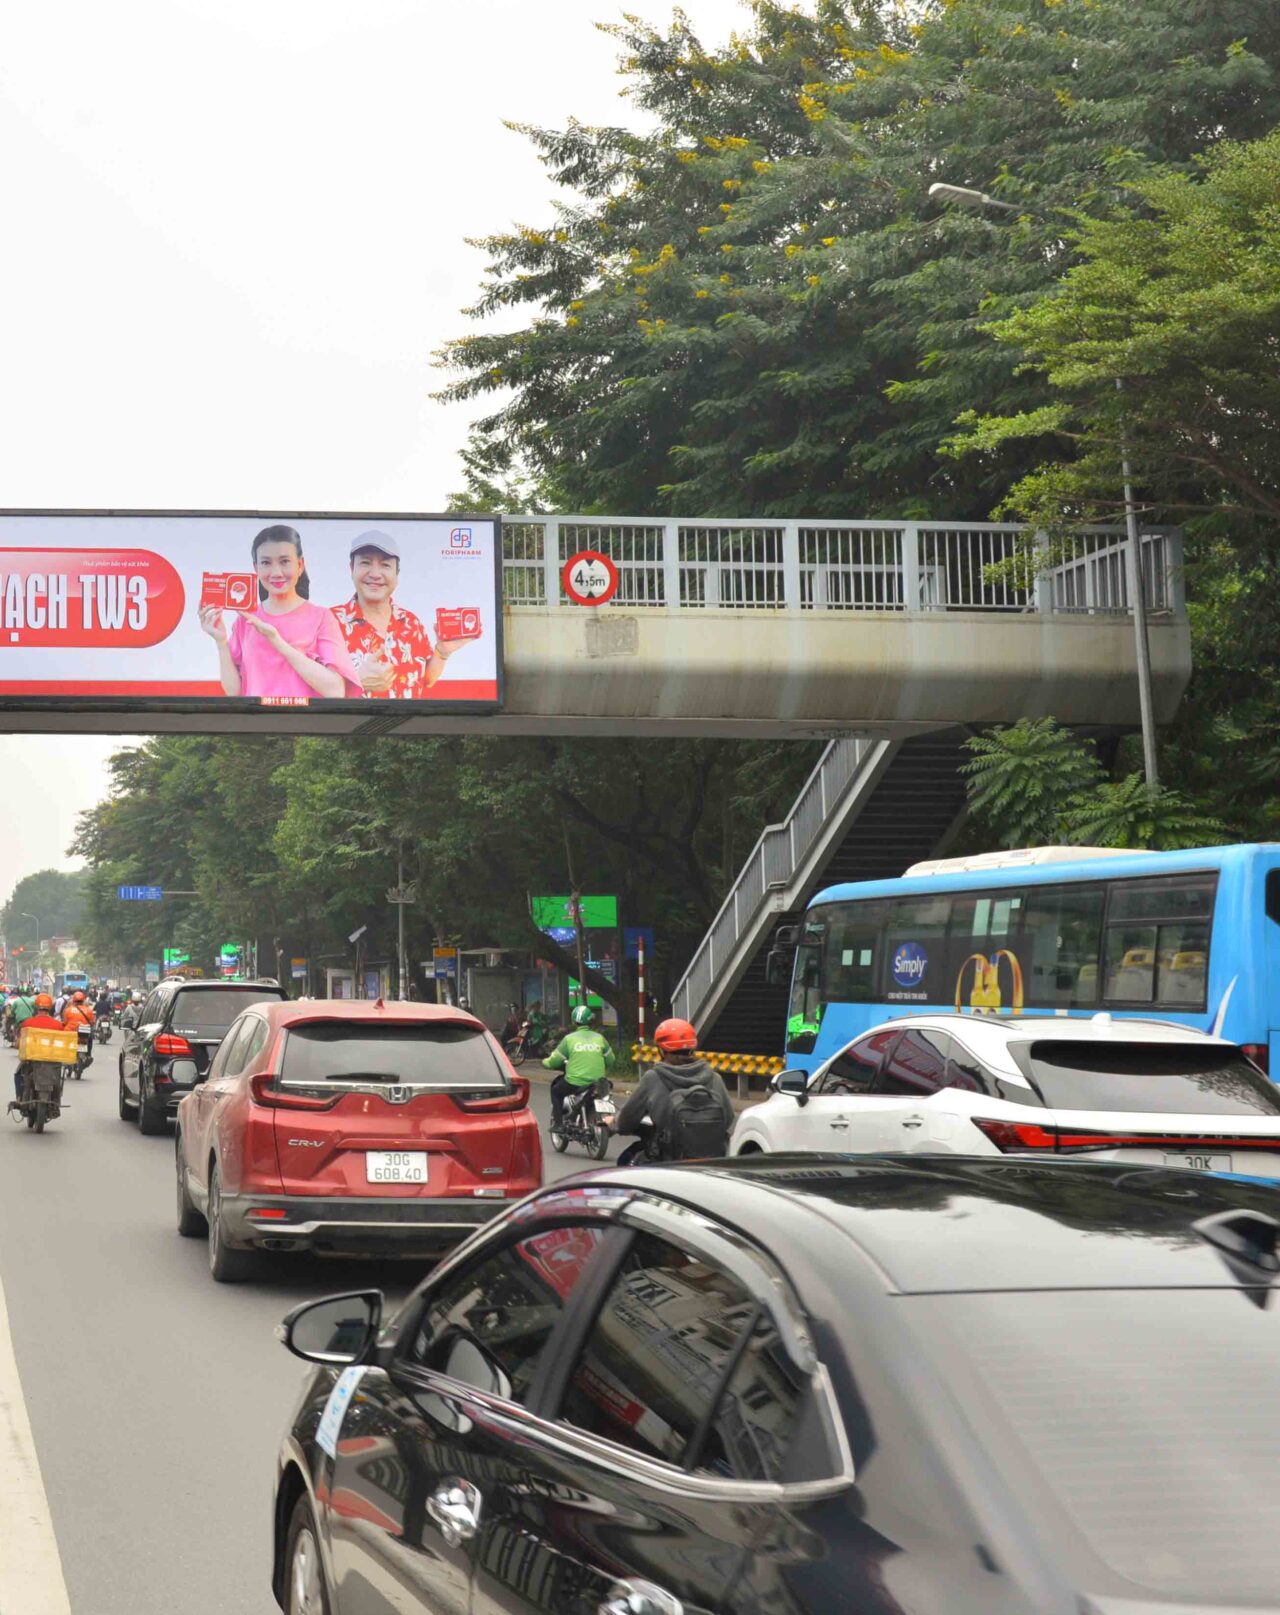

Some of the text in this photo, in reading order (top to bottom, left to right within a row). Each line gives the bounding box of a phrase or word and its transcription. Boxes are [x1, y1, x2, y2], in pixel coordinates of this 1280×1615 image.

[574, 570, 605, 587] 4,5m
[78, 574, 148, 631] TW3
[894, 955, 926, 978] Simply
[574, 1042, 601, 1052] Grab
[288, 1139, 325, 1148] CR-V
[385, 1153, 410, 1166] 30G
[1185, 1156, 1212, 1170] 30K
[375, 1167, 422, 1181] 608.40
